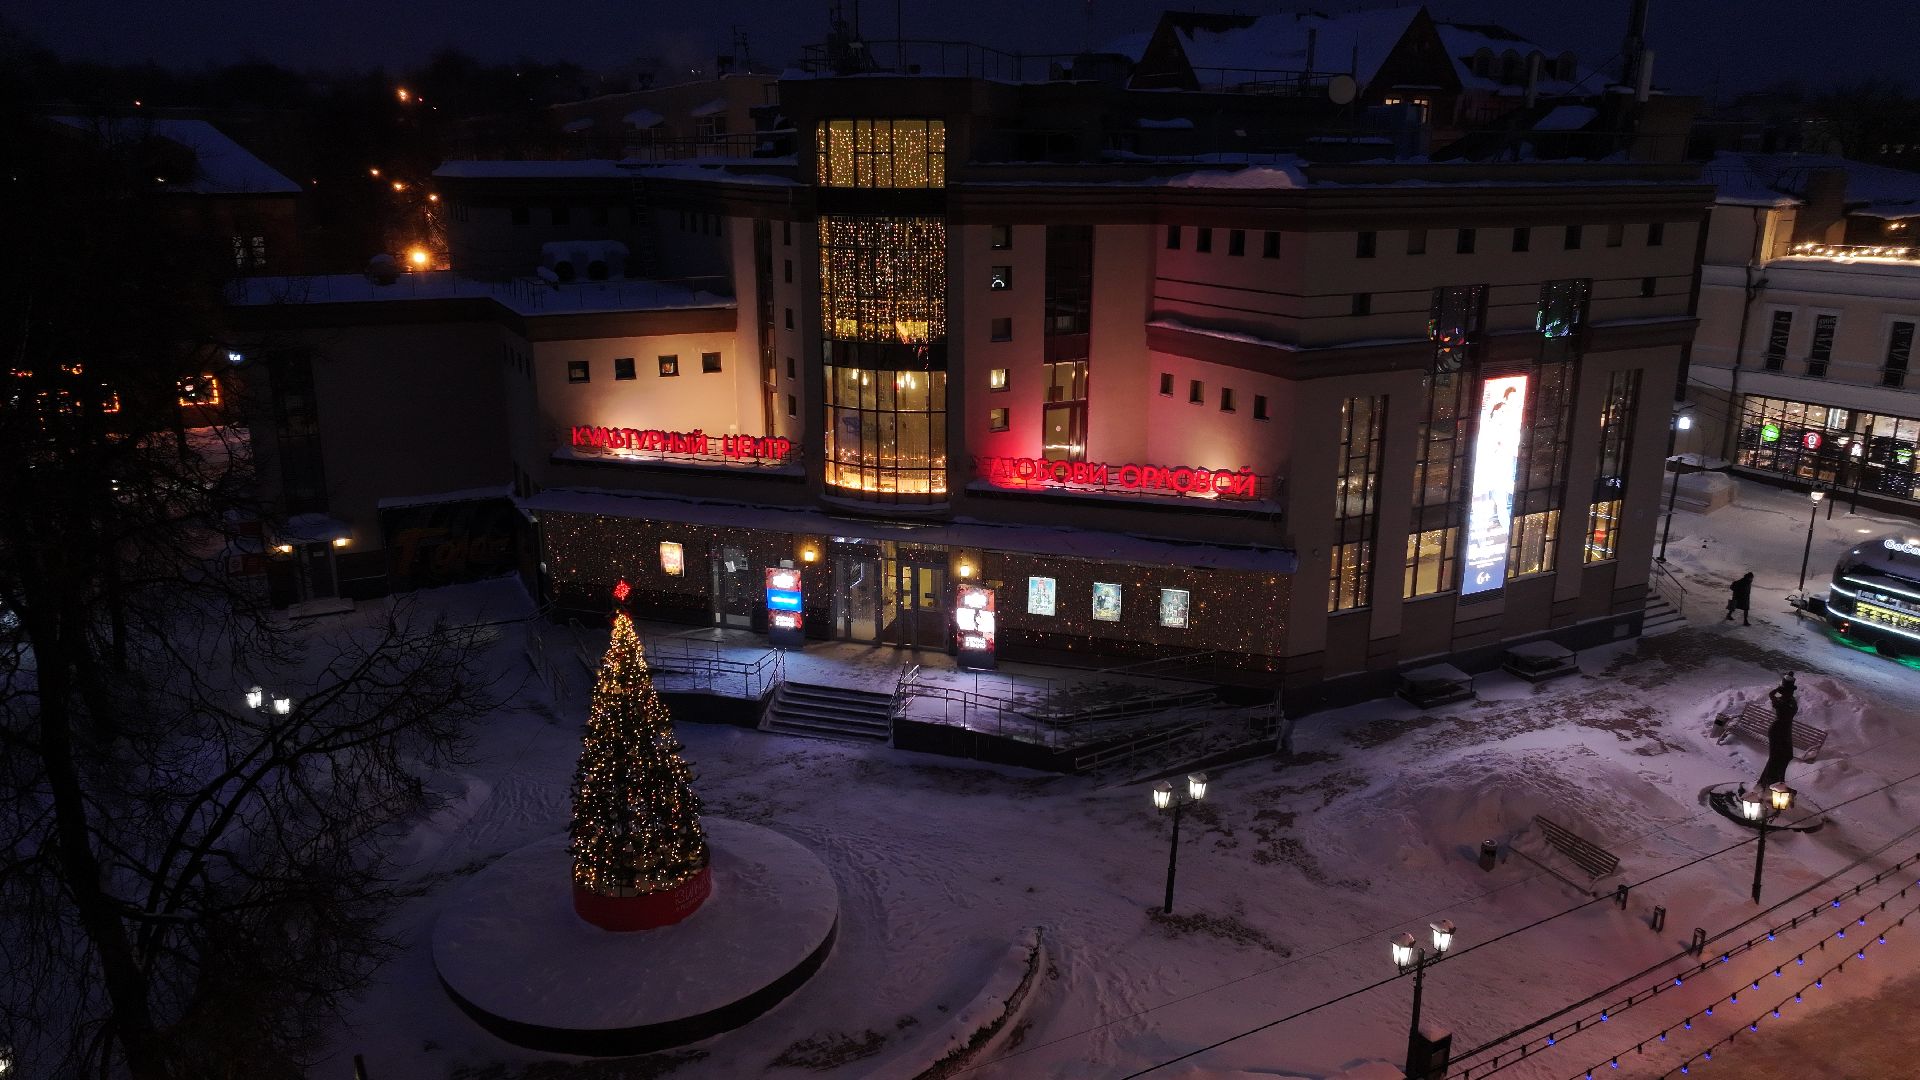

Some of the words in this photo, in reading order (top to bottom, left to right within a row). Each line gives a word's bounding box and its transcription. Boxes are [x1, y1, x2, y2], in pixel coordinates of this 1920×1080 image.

[572, 426, 708, 455] КУЛЬТУРНЫЙ
[722, 434, 791, 460] ЦЕНТР
[990, 457, 1107, 485] ЛЮБОВИ
[1118, 464, 1257, 496] ОРЛОВОЙ
[1477, 572, 1490, 585] 6+
